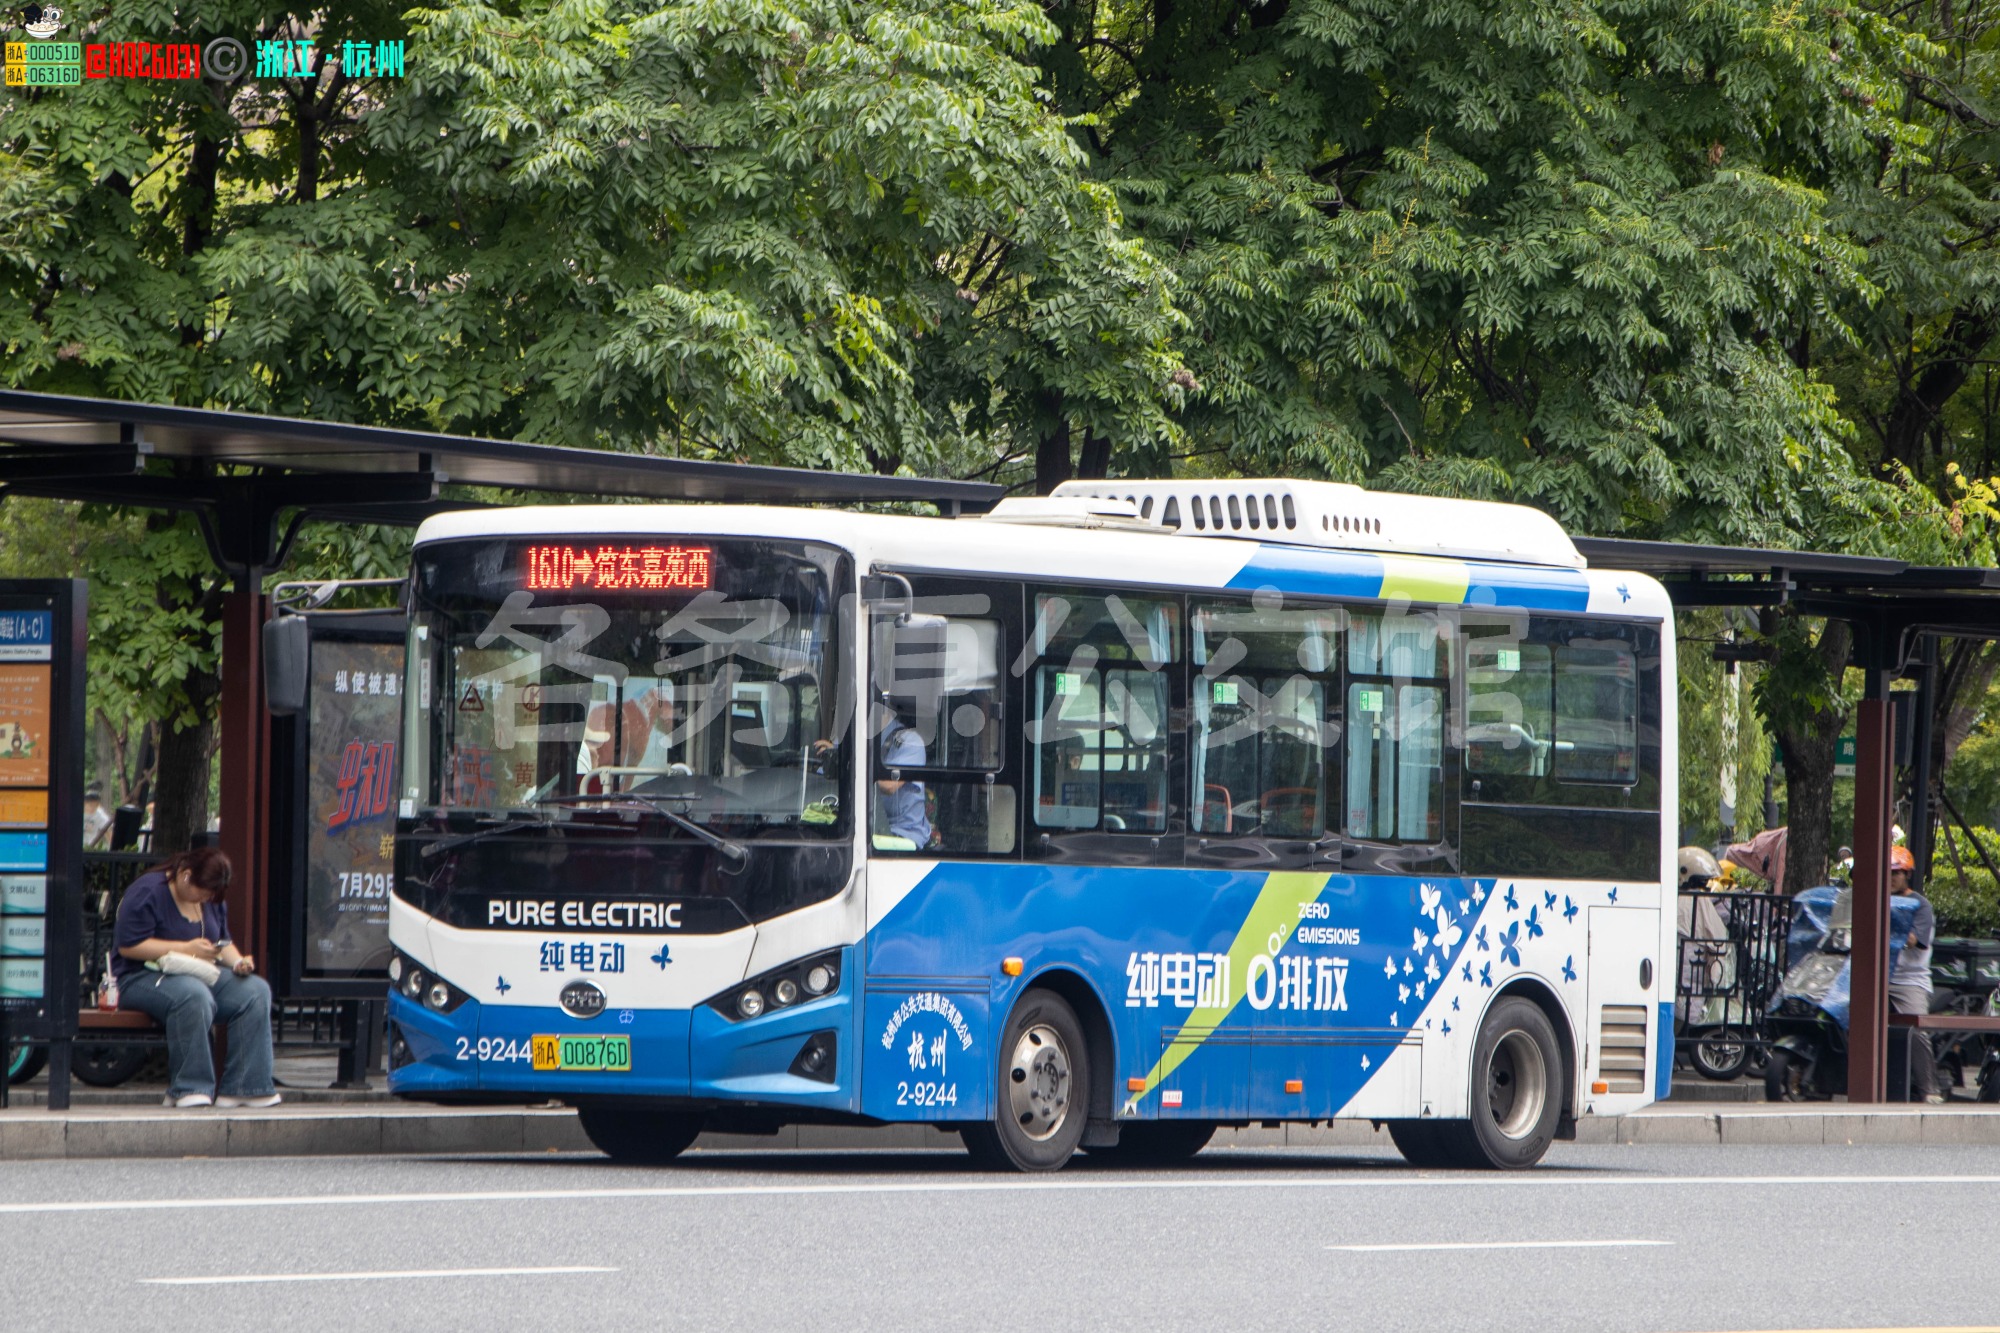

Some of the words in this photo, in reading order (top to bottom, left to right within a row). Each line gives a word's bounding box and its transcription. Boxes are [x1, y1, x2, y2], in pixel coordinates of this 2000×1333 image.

[528, 547, 575, 588] 1610
[335, 670, 403, 696] 纵使被遗
[488, 900, 556, 928] PURE
[562, 902, 683, 929] ELECTRIC
[1298, 902, 1330, 919] ZERO
[1297, 927, 1360, 945] EMISSIONS
[539, 941, 626, 974] 纯电动
[1125, 952, 1231, 1009] 纯电动
[563, 989, 601, 1008] BYD
[456, 1036, 533, 1063] 2-9244
[907, 1028, 947, 1077] 杭州
[896, 1081, 957, 1107] 2-9244
